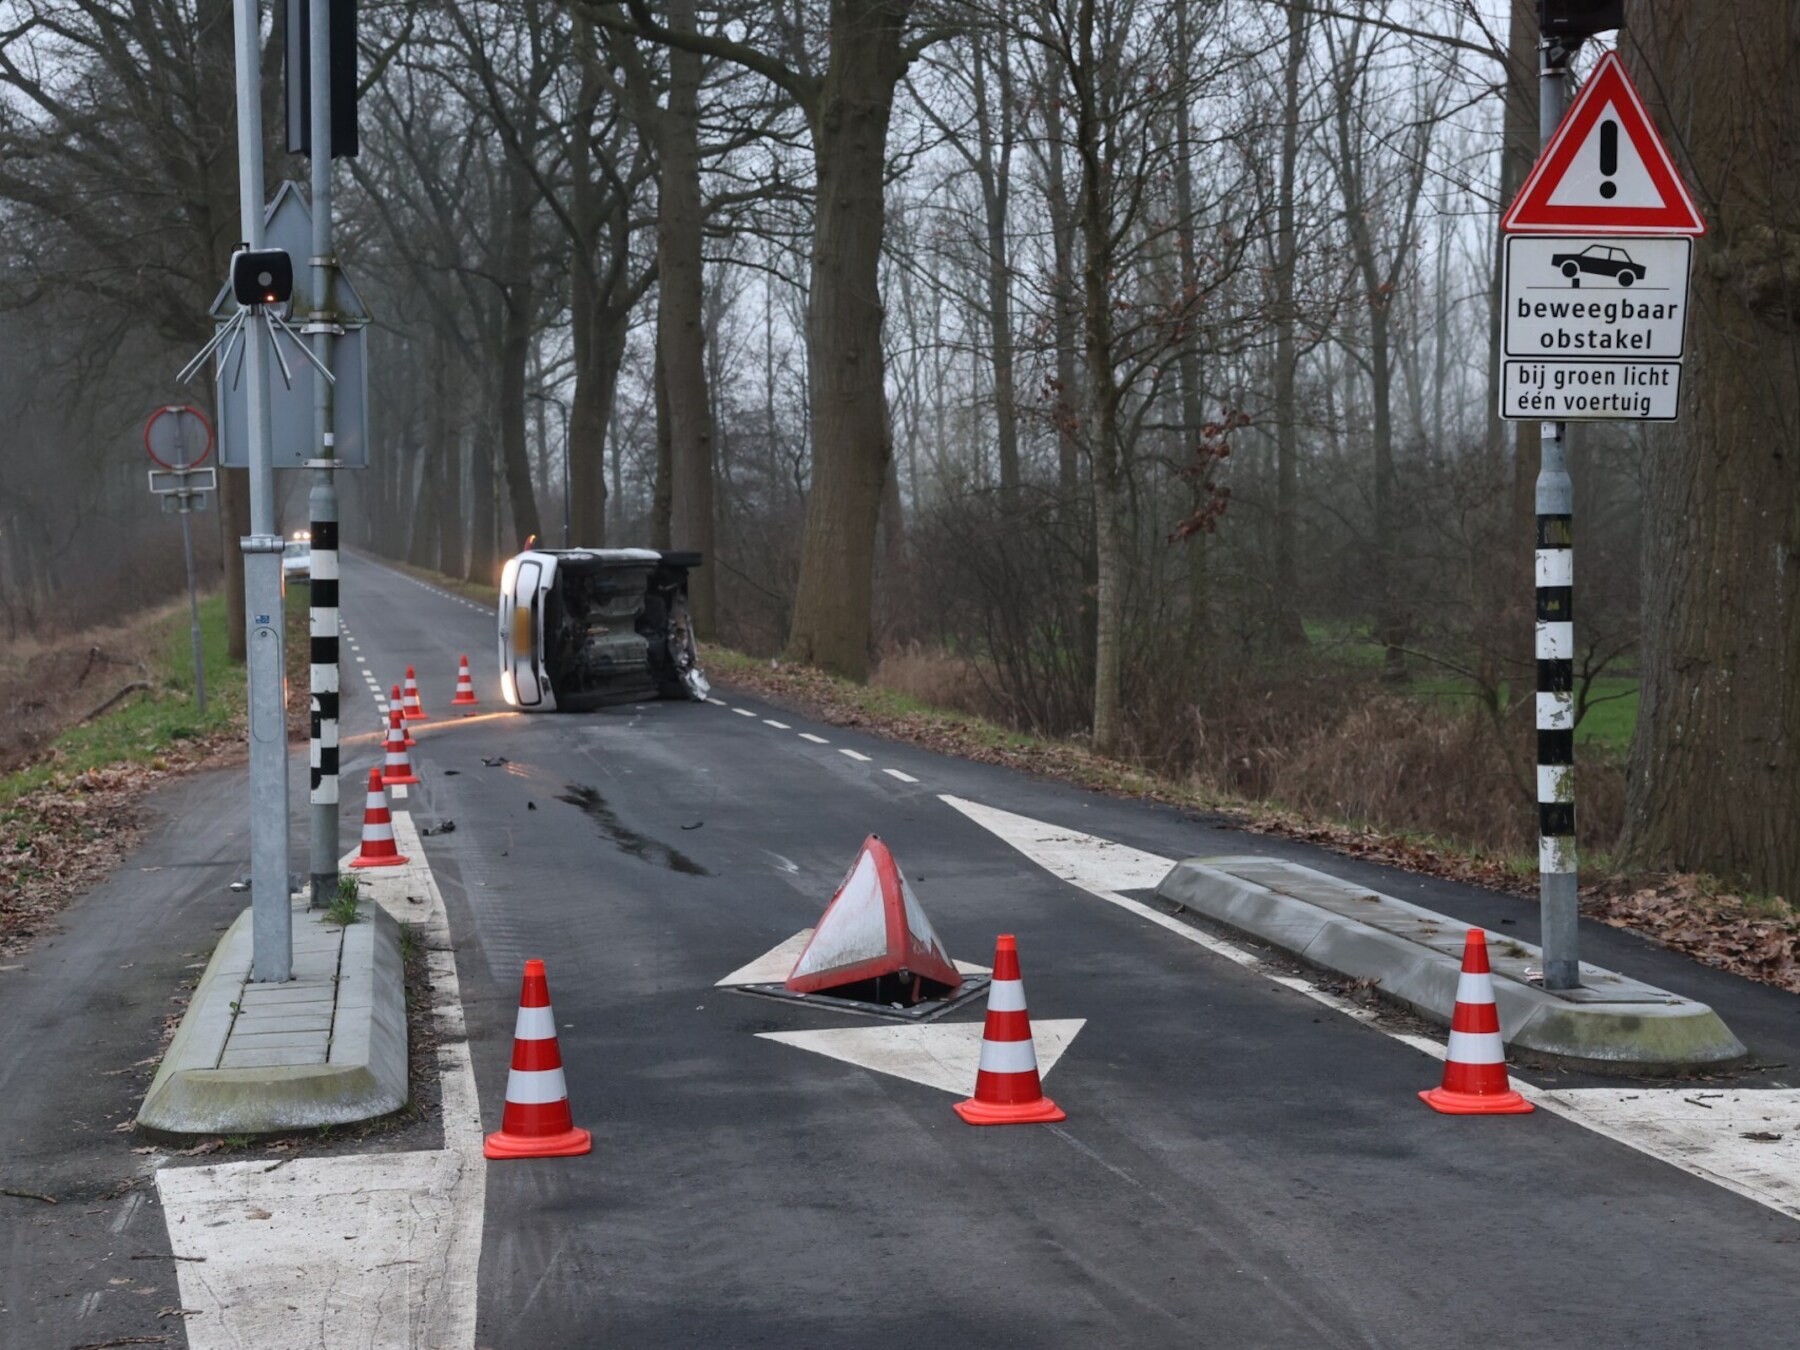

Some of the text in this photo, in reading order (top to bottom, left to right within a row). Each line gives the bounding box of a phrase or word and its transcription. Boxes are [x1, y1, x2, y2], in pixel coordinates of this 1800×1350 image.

[1518, 298, 1678, 324] beweegbaar
[1541, 328, 1652, 350] obstakel
[1519, 365, 1669, 389] bij groen licht
[1518, 391, 1651, 415] één voertuig
